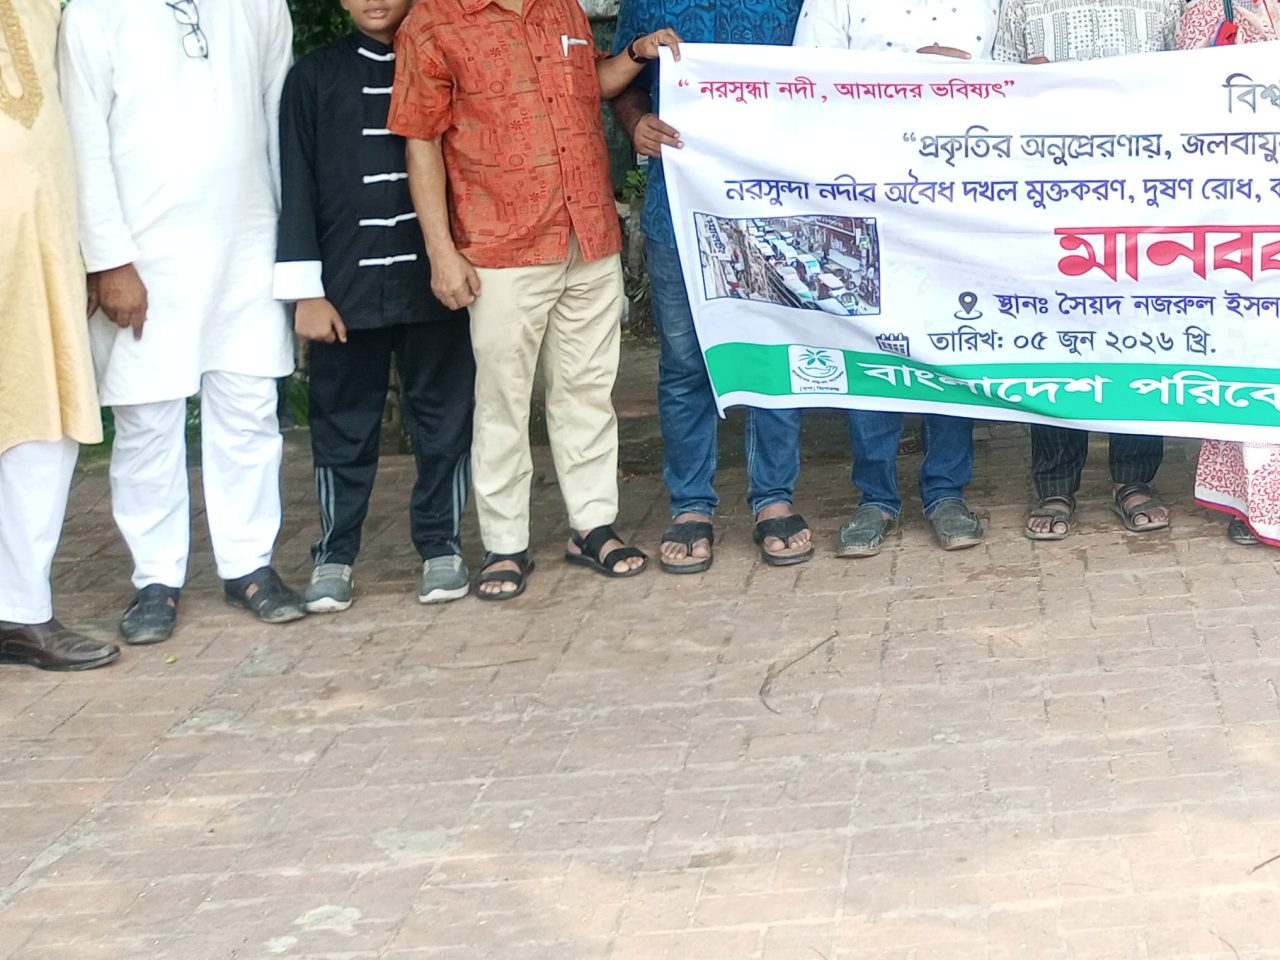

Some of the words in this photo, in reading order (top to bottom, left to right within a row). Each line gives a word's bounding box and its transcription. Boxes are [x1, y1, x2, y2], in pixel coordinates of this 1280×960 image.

[834, 81, 923, 100] আমাদের
[902, 124, 1014, 168] “প্রকৃতির
[1020, 133, 1172, 167] অনুপ্রেরণায়,
[724, 179, 809, 207] নরসুন্দা
[816, 174, 877, 203] নদীর
[884, 169, 955, 205] অবৈধ
[962, 180, 1018, 202] দখল
[1026, 179, 1134, 208] মুক্তকরণ,
[1201, 178, 1262, 203] রোধ,
[1055, 290, 1124, 317] সৈয়দ
[1131, 294, 1217, 317] নজরুল
[1013, 332, 1049, 351] ০৫
[1057, 330, 1096, 357] জুন
[1106, 331, 1175, 354] ২০২৬
[1182, 325, 1217, 357] খ্রি.
[857, 362, 1113, 404] বাংলাদেশ
